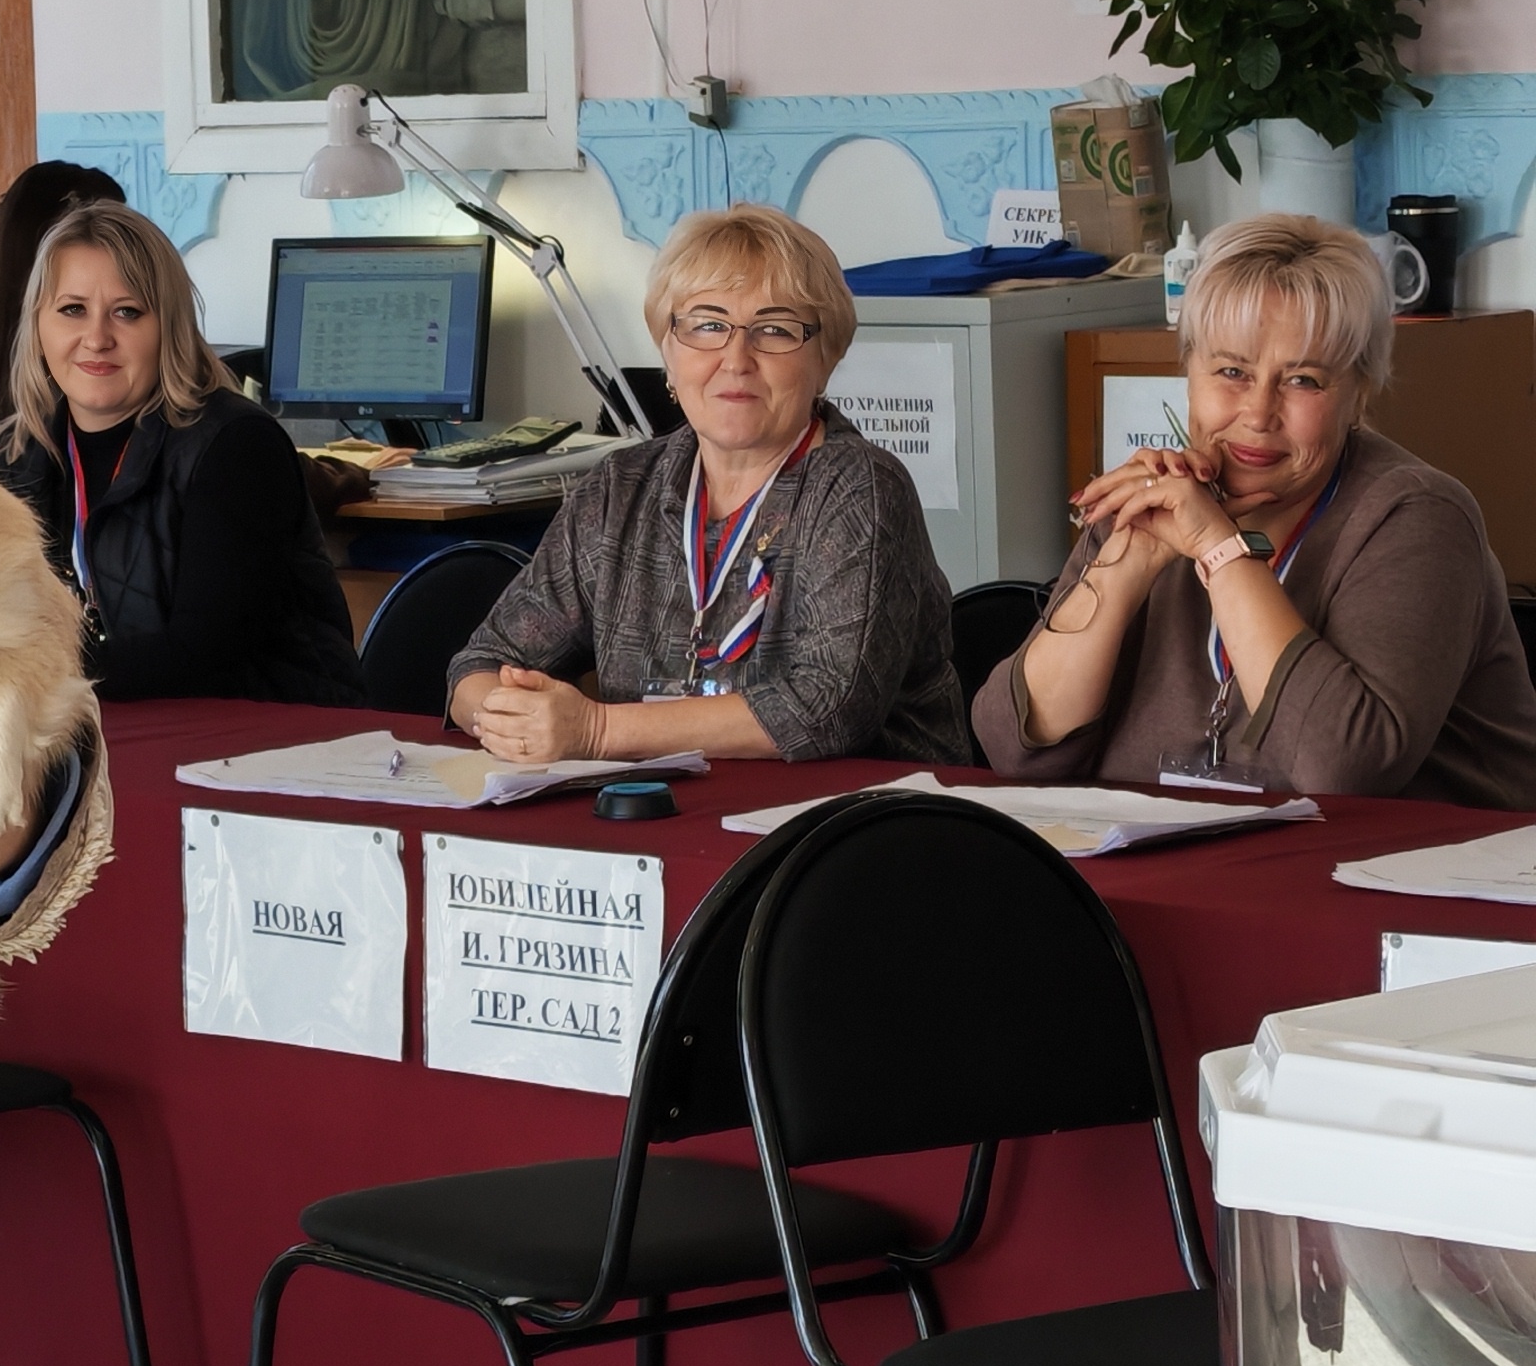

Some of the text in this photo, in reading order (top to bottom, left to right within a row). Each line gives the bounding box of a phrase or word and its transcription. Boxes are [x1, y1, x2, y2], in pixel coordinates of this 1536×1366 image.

[1004, 206, 1060, 224] СЕКРЕ
[857, 397, 934, 413] ХРАНЕНИЯ
[849, 416, 930, 434] АТЕЛЬНОЙ
[1126, 433, 1181, 448] МЕСТО
[448, 872, 643, 922] ЮБИЛЕЙНАЯ
[252, 899, 344, 937] НОВАЯ
[461, 931, 633, 979] И. ГРЯЗИНА
[471, 988, 622, 1039] ТЕР. САД 2
